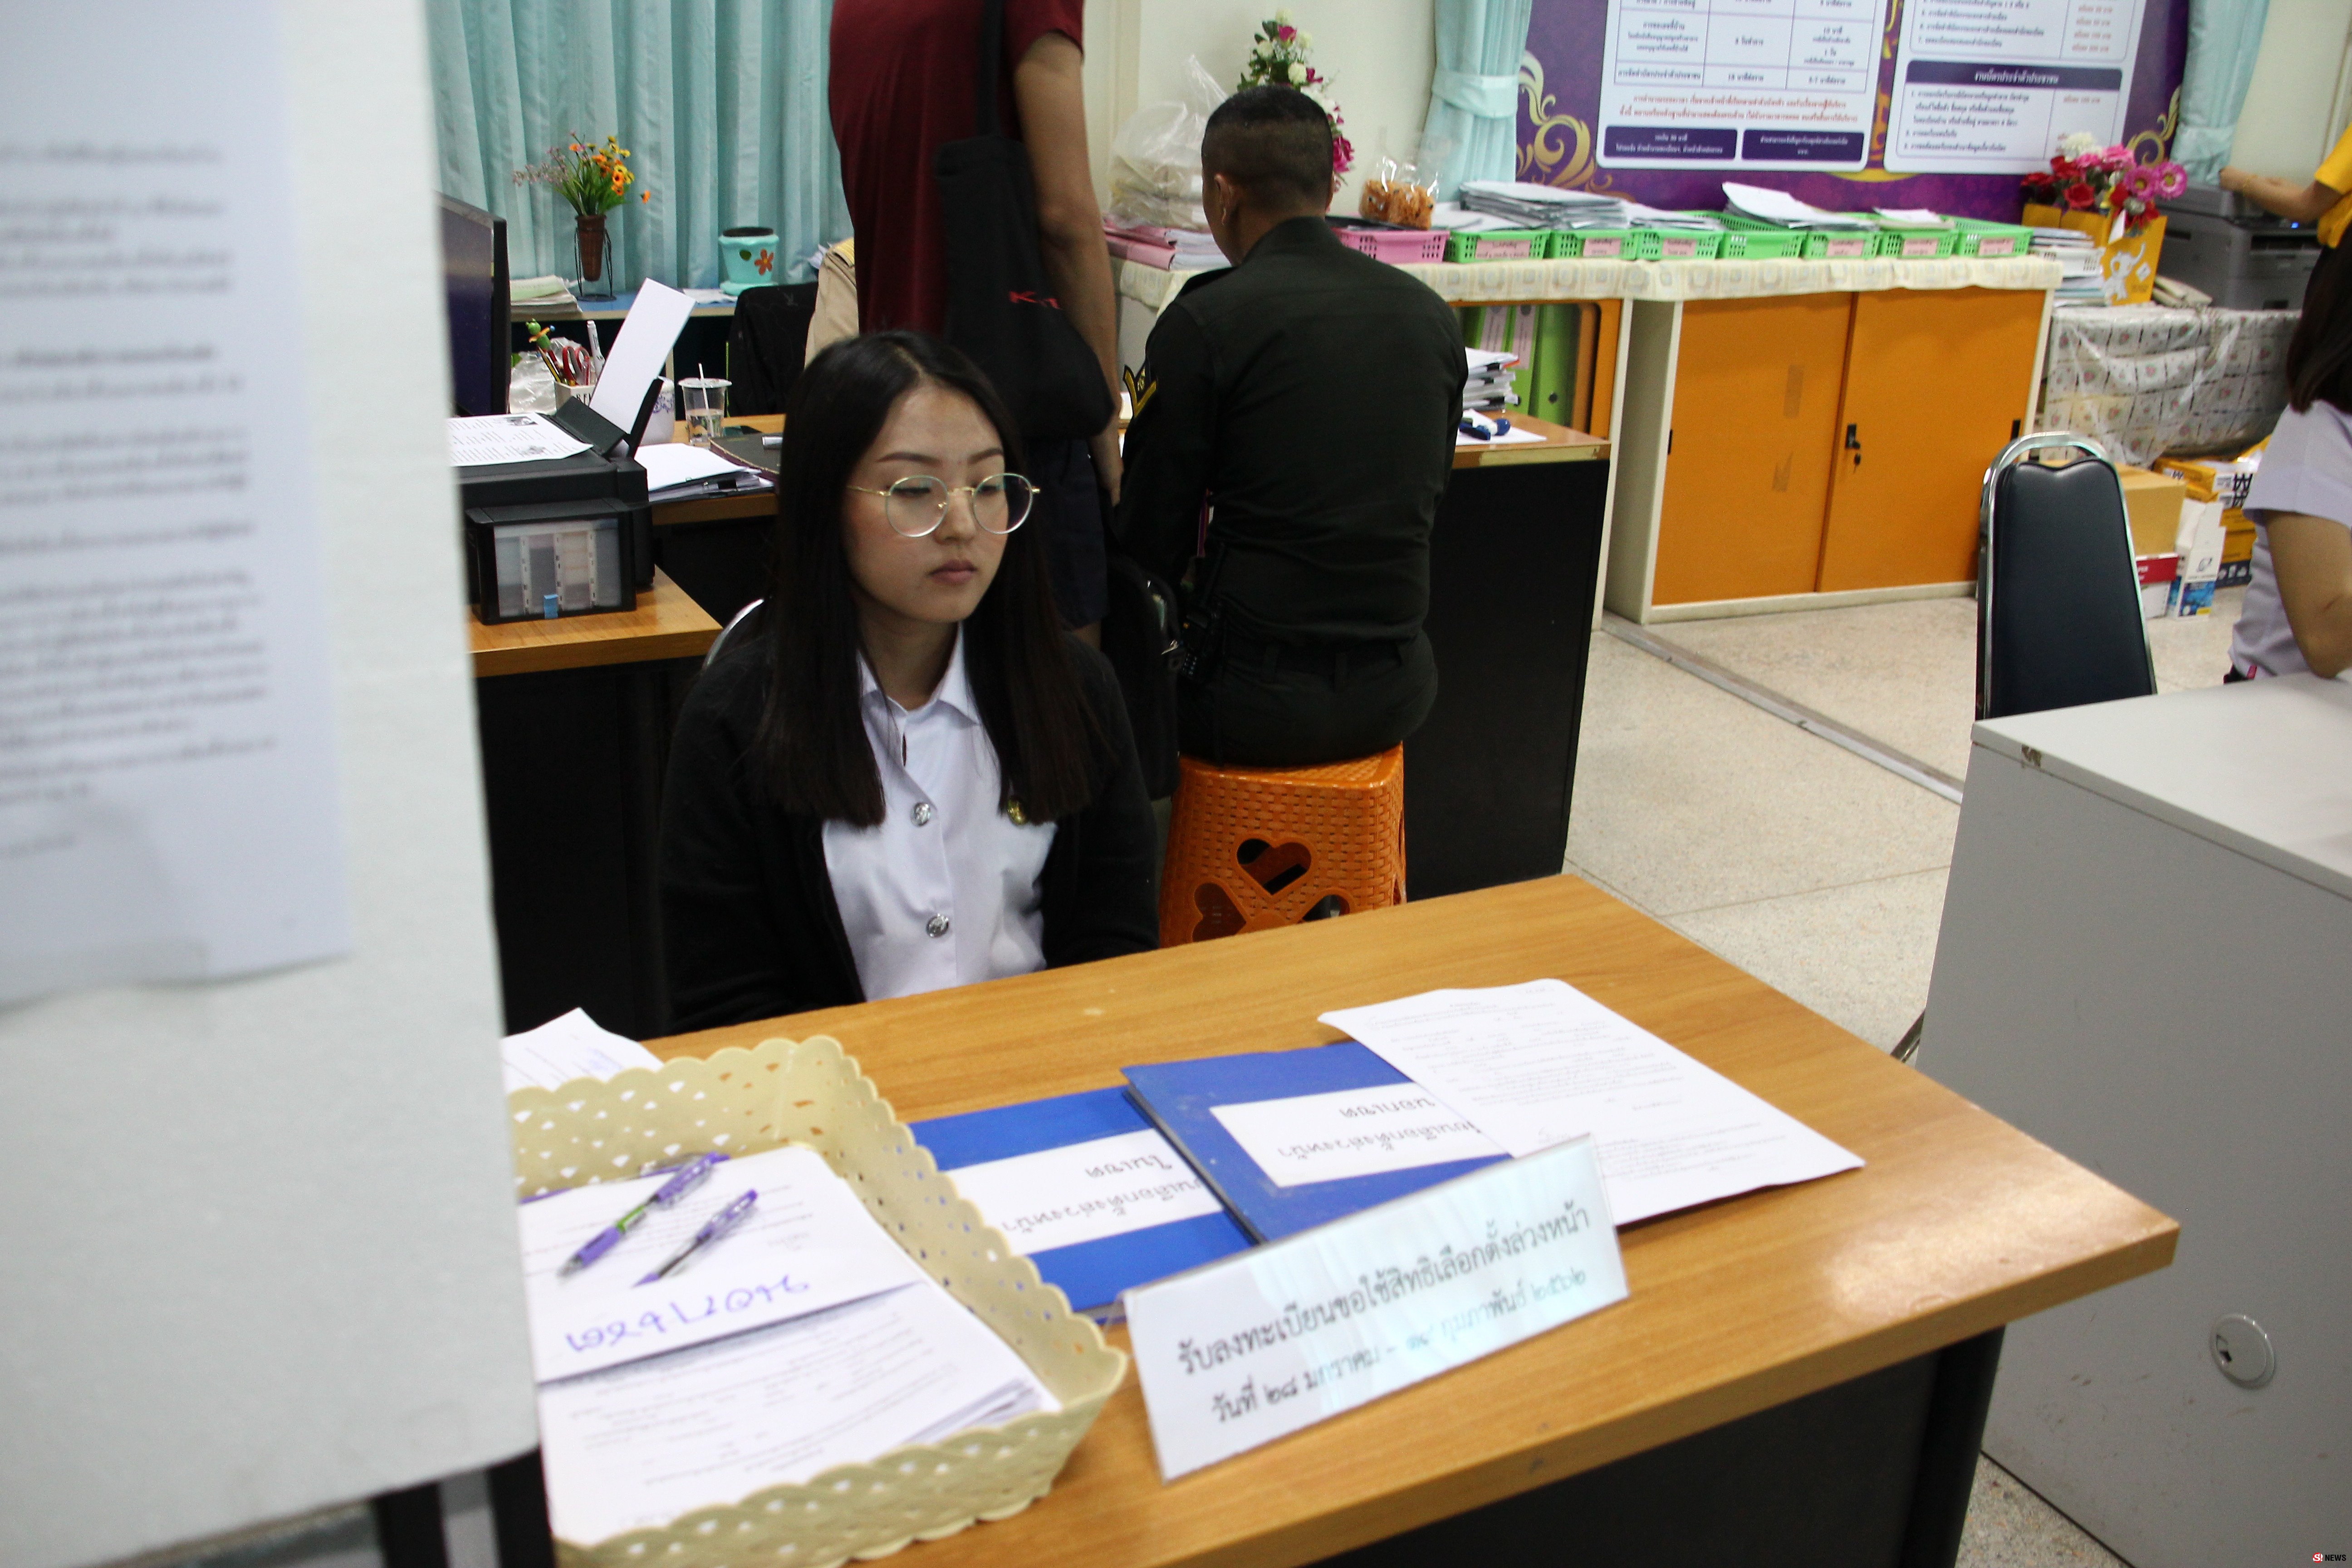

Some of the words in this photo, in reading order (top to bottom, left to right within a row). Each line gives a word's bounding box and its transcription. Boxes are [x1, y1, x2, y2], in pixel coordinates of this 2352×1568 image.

[1339, 1097, 1436, 1118] นอกเขต
[1085, 1154, 1172, 1178] ในเขต
[1178, 1200, 1591, 1375] รับลงทะเบียนขอใช้สิทธิเลือกตั้งล่วงหน้า
[1212, 1374, 1259, 1423] วันที่
[1264, 1376, 1298, 1405] ๒๘
[1303, 1345, 1381, 1390] มกราคม
[1441, 1278, 1527, 1343] กุมภาพันธ์
